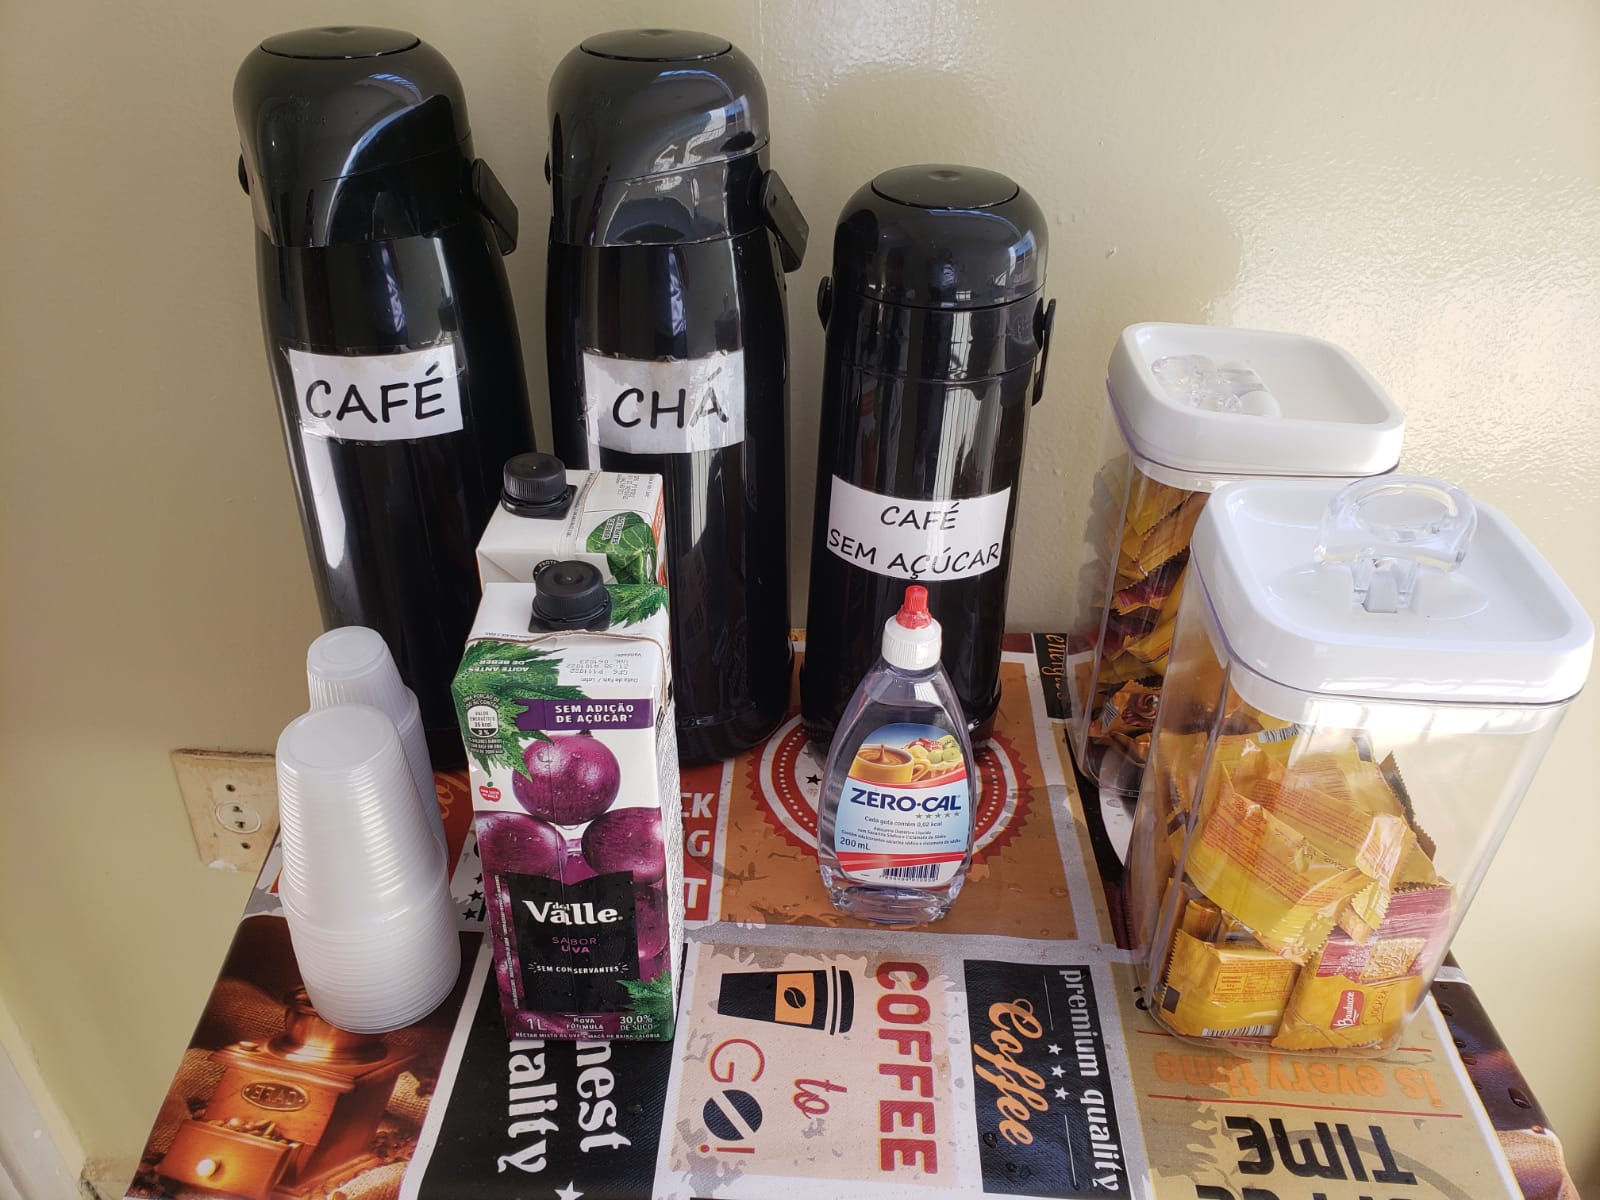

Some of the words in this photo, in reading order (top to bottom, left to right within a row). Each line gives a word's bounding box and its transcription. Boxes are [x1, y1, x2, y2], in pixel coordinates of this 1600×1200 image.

[305, 361, 446, 423] CAFÉ
[612, 367, 729, 429] CHÁ
[880, 502, 960, 530] CAFÉ
[828, 529, 877, 565] SEM
[887, 546, 1000, 579] AÇÚCAR
[554, 705, 582, 713] SEM
[586, 702, 635, 714] ADIÇÃO
[556, 714, 573, 723] DE
[850, 787, 962, 812] ZERO-CAL
[864, 815, 880, 823] Cada
[839, 837, 857, 847] 200
[857, 842, 871, 851] mL
[522, 900, 618, 926] Valle
[552, 936, 598, 945] SABOR
[561, 945, 591, 954] UVA
[536, 964, 553, 972] SEM
[555, 965, 620, 974] CONSERVANTES
[573, 1016, 596, 1024] NOVA
[619, 1014, 653, 1025] 30,0%
[620, 1023, 631, 1031] DE
[631, 1023, 653, 1031] SUCO
[874, 961, 939, 1174] COFFEE
[973, 998, 1050, 1146] Coffee
[1058, 968, 1101, 1077] premium
[1080, 1088, 1121, 1192] quality
[1153, 1050, 1259, 1098] time
[1268, 1053, 1388, 1098] every
[497, 1041, 559, 1174] ality
[576, 1040, 632, 1153] nest
[793, 1077, 848, 1121] to
[1223, 1115, 1418, 1186] TIME
